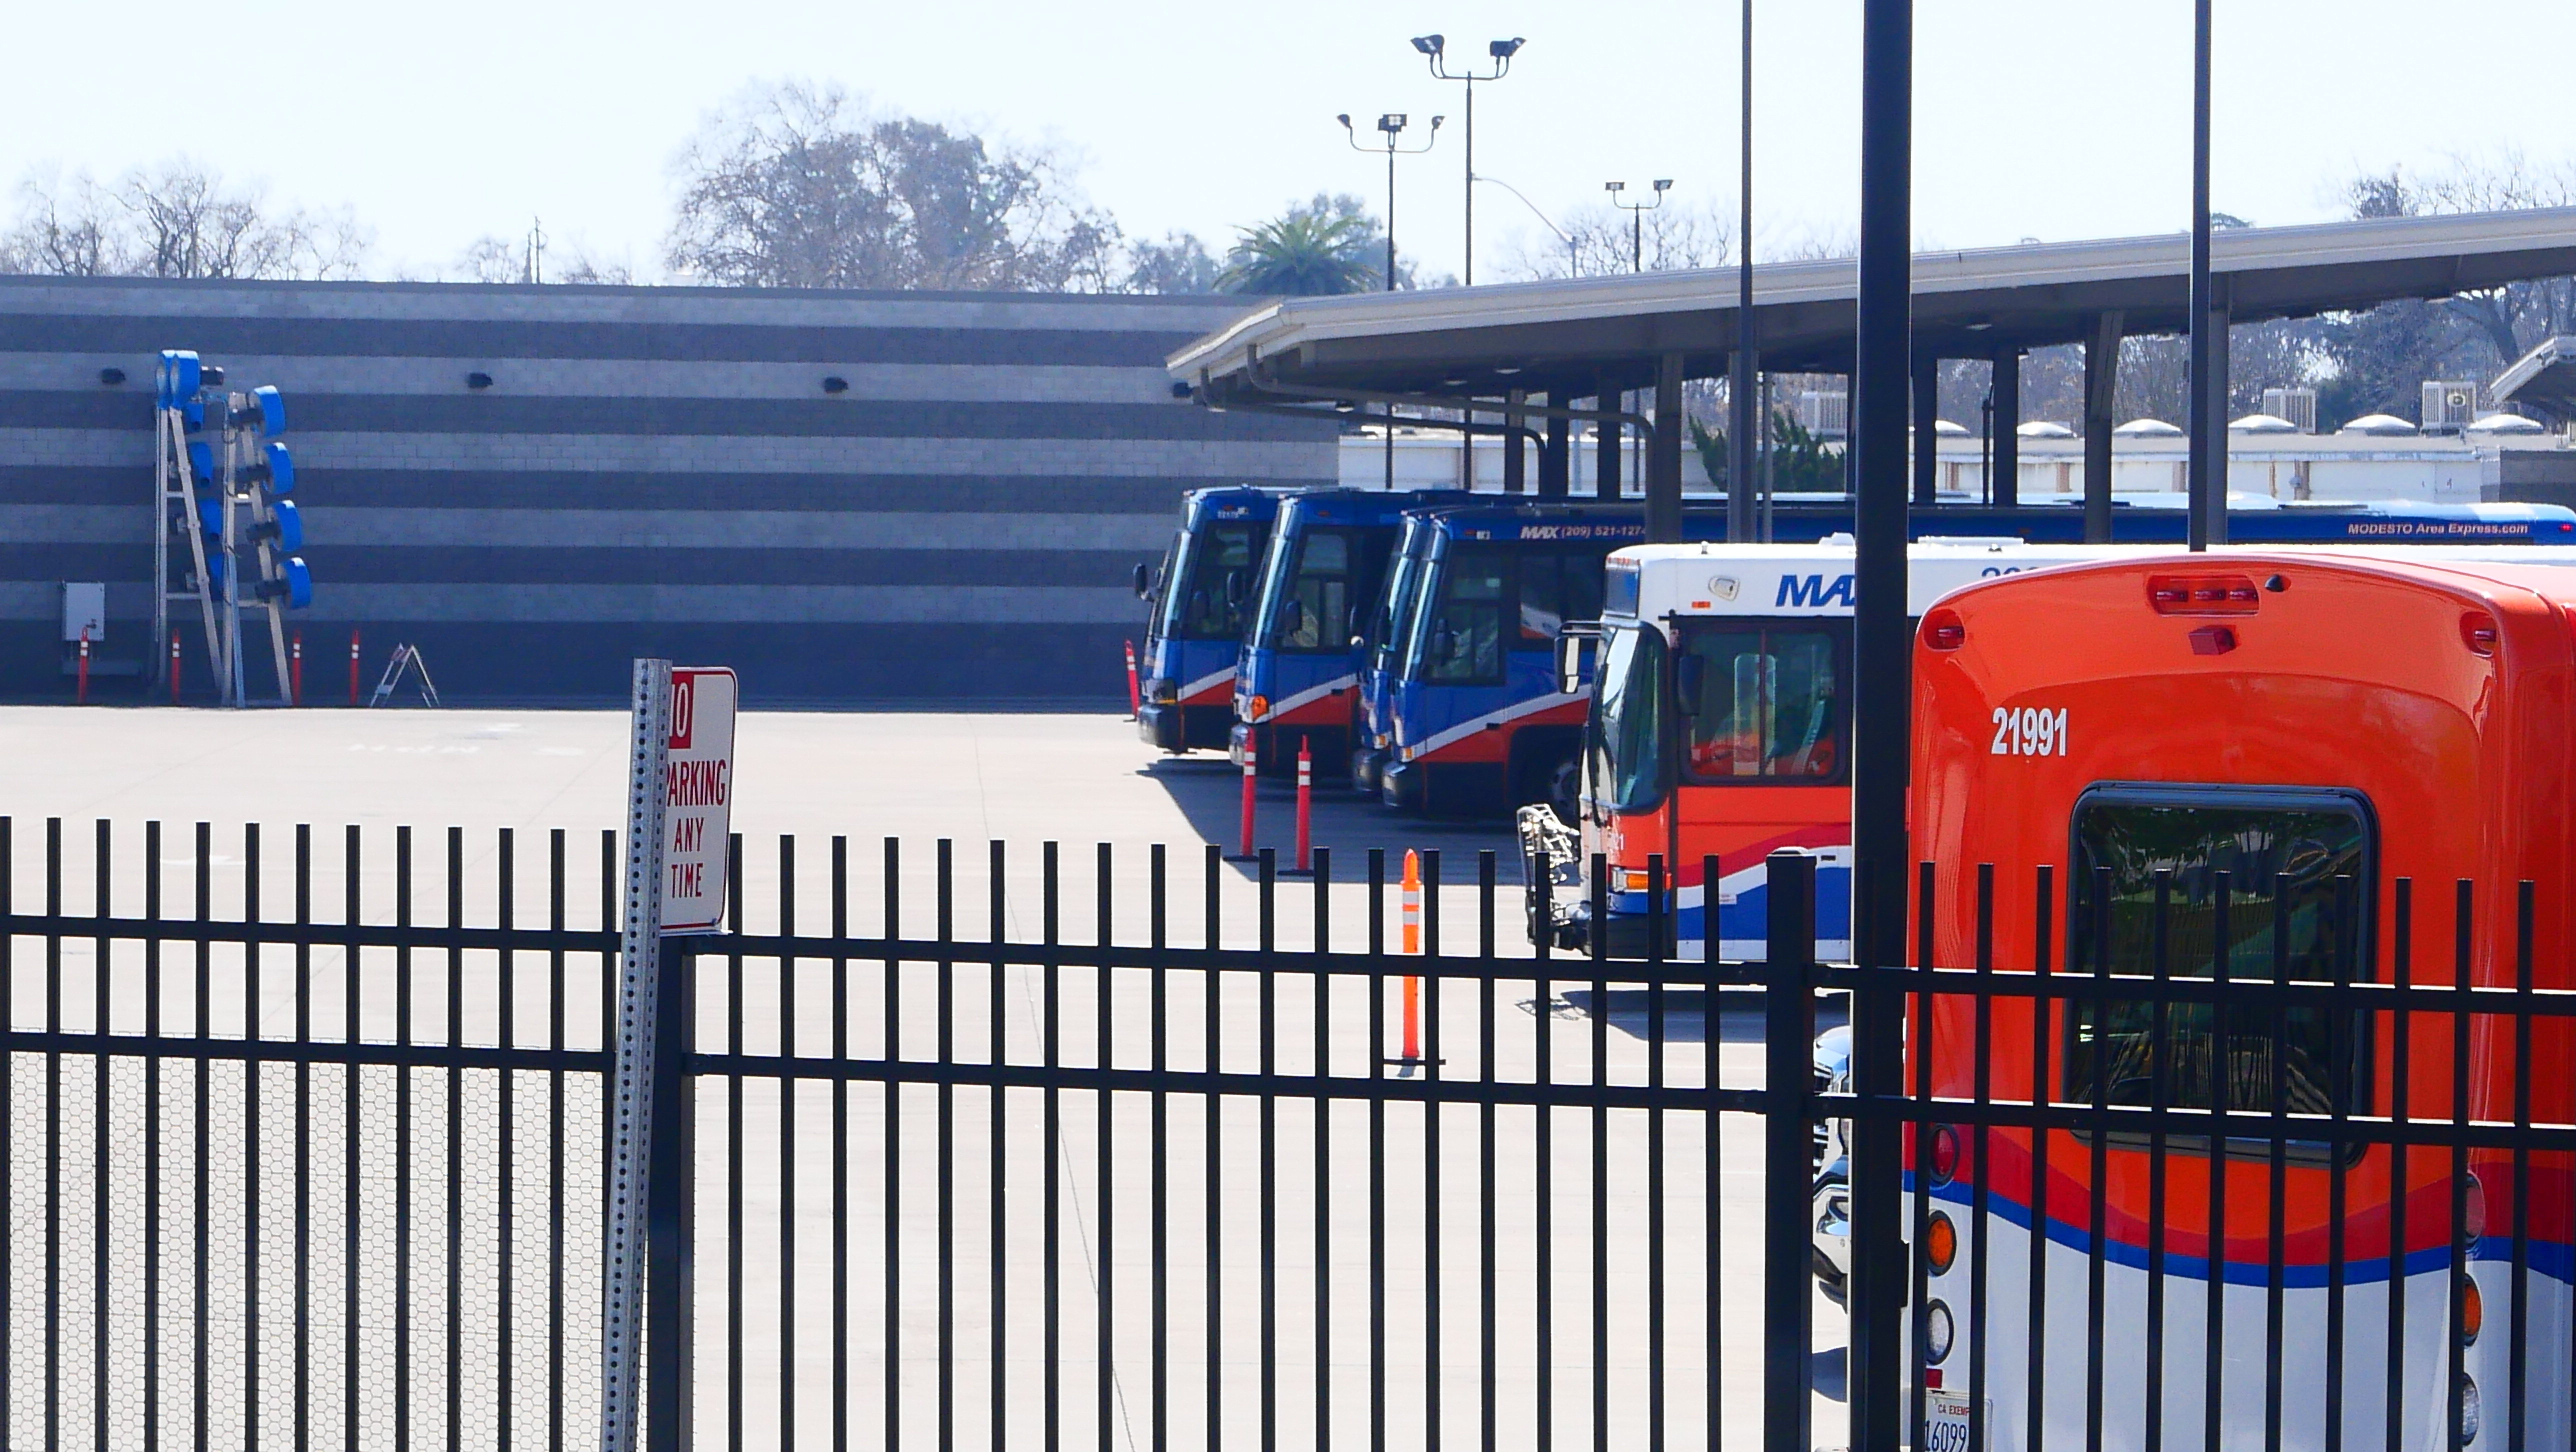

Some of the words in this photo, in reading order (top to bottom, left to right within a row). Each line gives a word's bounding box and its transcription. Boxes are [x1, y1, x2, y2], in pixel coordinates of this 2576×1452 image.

[1520, 526, 1558, 539] MAX
[1561, 526, 1591, 538] (209)
[2348, 524, 2412, 534] MODESTO
[2416, 524, 2444, 534] Area
[2448, 524, 2528, 536] Express.com
[1776, 574, 1855, 607] MA
[1992, 707, 2067, 757] 21991
[674, 817, 704, 852] ANY
[672, 862, 704, 898] TIME
[1938, 1404, 1946, 1414] CA
[1949, 1405, 1970, 1416] EXEMP
